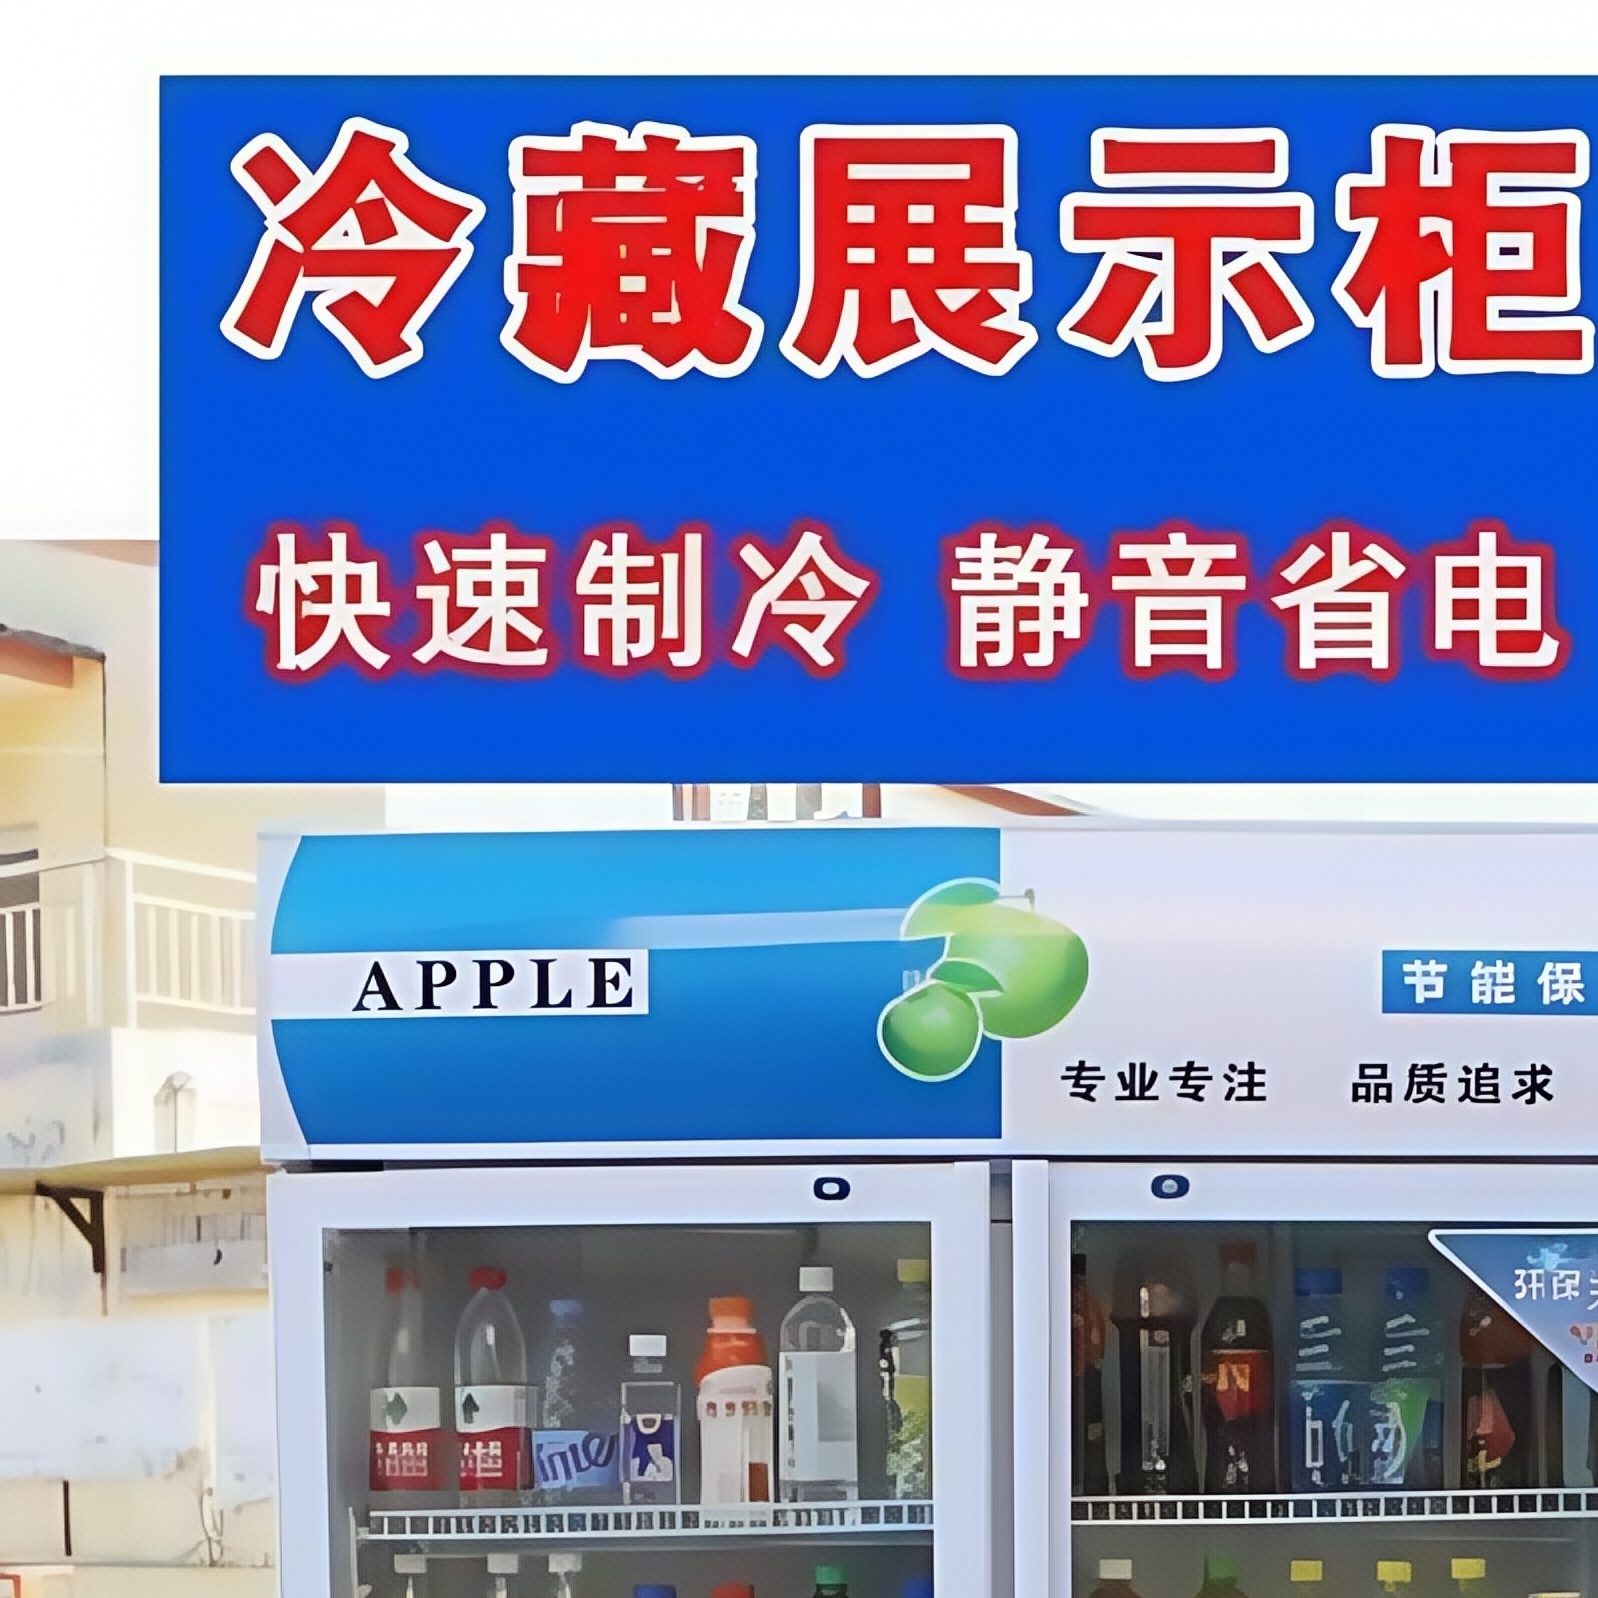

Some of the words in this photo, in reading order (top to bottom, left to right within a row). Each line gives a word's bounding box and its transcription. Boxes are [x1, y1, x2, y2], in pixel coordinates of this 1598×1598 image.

[352, 956, 640, 1013] APPLE
[1060, 1060, 1268, 1104] 专业专注
[1350, 1061, 1555, 1105] 品质追求
